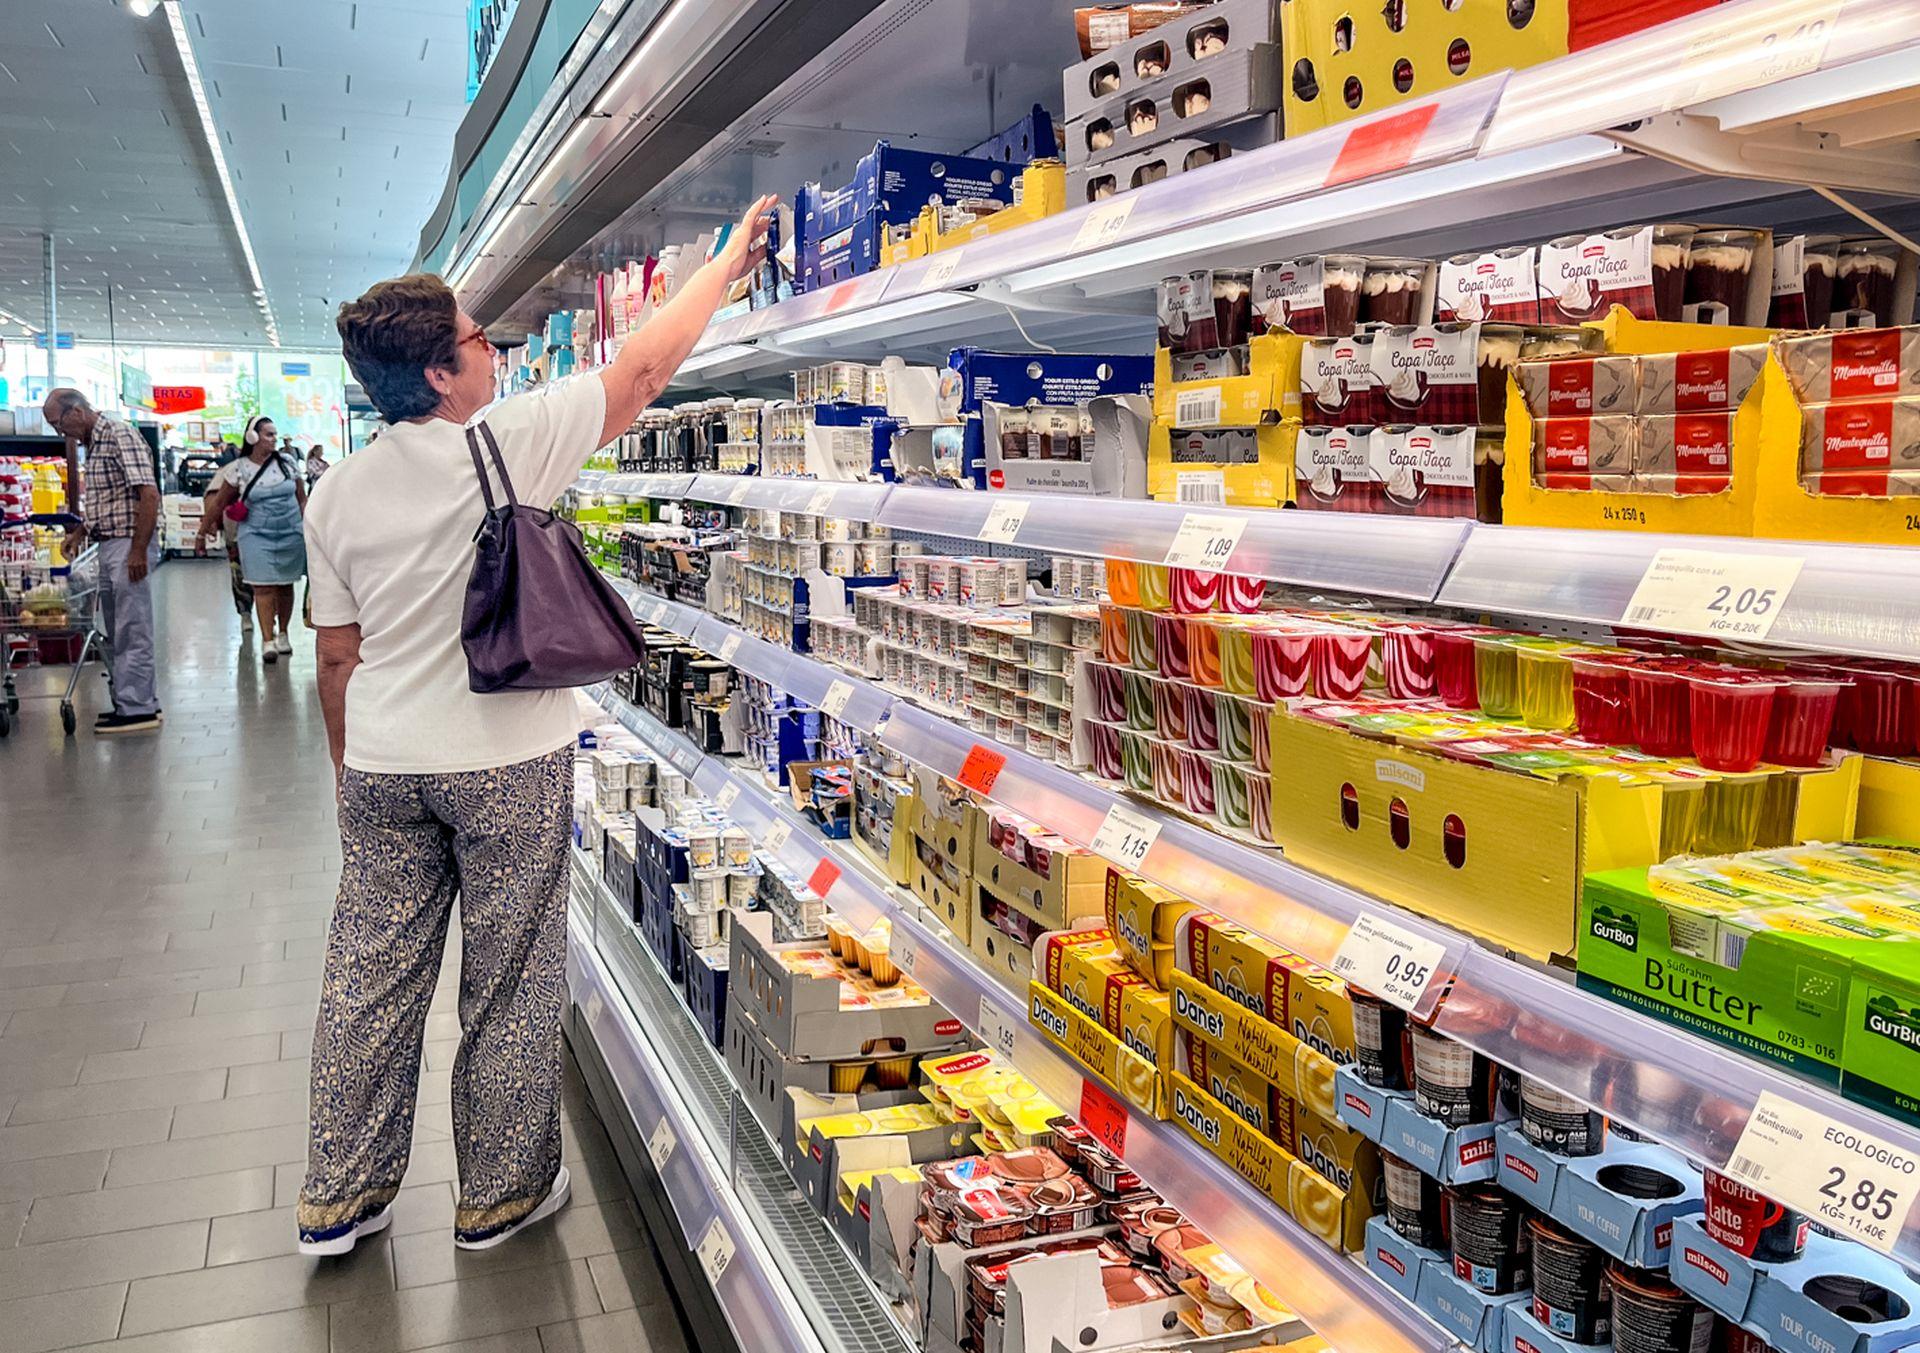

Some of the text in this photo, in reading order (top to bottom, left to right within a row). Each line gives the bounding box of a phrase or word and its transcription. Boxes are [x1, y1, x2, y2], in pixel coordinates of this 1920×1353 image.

[1833, 359, 1897, 381] Mantequilla
[1550, 387, 1591, 403] Mantequilla
[1677, 379, 1726, 396] Mantequilla
[1546, 446, 1588, 459] Mantequilla
[1677, 442, 1727, 458] Mantequilla
[1825, 432, 1888, 452] Mantequilla
[1603, 506, 1614, 520] 24
[1622, 508, 1637, 521] 250
[1204, 537, 1233, 557] 1,09
[1655, 563, 1724, 576] Mantequilla con sal
[1706, 585, 1777, 617] 2,05
[1709, 619, 1732, 630] KG=
[1377, 763, 1422, 787] milsani
[1121, 833, 1149, 859] 1,15
[1058, 930, 1097, 945] PACK
[1118, 913, 1148, 953] Danet
[1385, 954, 1429, 987] 0,95
[1666, 958, 1713, 983] Süßrahm
[1644, 957, 1763, 1026] Butter
[1033, 997, 1069, 1040] Danet
[1176, 987, 1225, 1041] Danet
[1611, 987, 1796, 1064] KONTROLLIERT ÖKOLOGISCHE ERZEUGUNG
[935, 1024, 961, 1033] MILSANI
[998, 1025, 1014, 1048] 1,55
[1777, 1029, 1805, 1049] 0783
[1814, 1043, 1836, 1060] 016
[941, 1056, 986, 1074] MILSANI
[1212, 1075, 1263, 1131] Danet
[1175, 1089, 1221, 1146] Danet
[1755, 1113, 1804, 1141] Mantequilla
[1103, 1121, 1124, 1150] 3,49
[1232, 1125, 1273, 1173] Natillas
[1402, 1132, 1436, 1161] YOUR COFFEE
[1823, 1126, 1916, 1175] ECOLOGICO
[1506, 1155, 1537, 1181] milsani
[1818, 1165, 1899, 1221] 2,85
[1577, 1204, 1621, 1241] YOUR COFFEE
[1708, 1195, 1743, 1231] Latte
[1819, 1201, 1888, 1241] KG= 11,40€
[1686, 1250, 1728, 1283] milsani
[1779, 1312, 1803, 1338] YOUR
